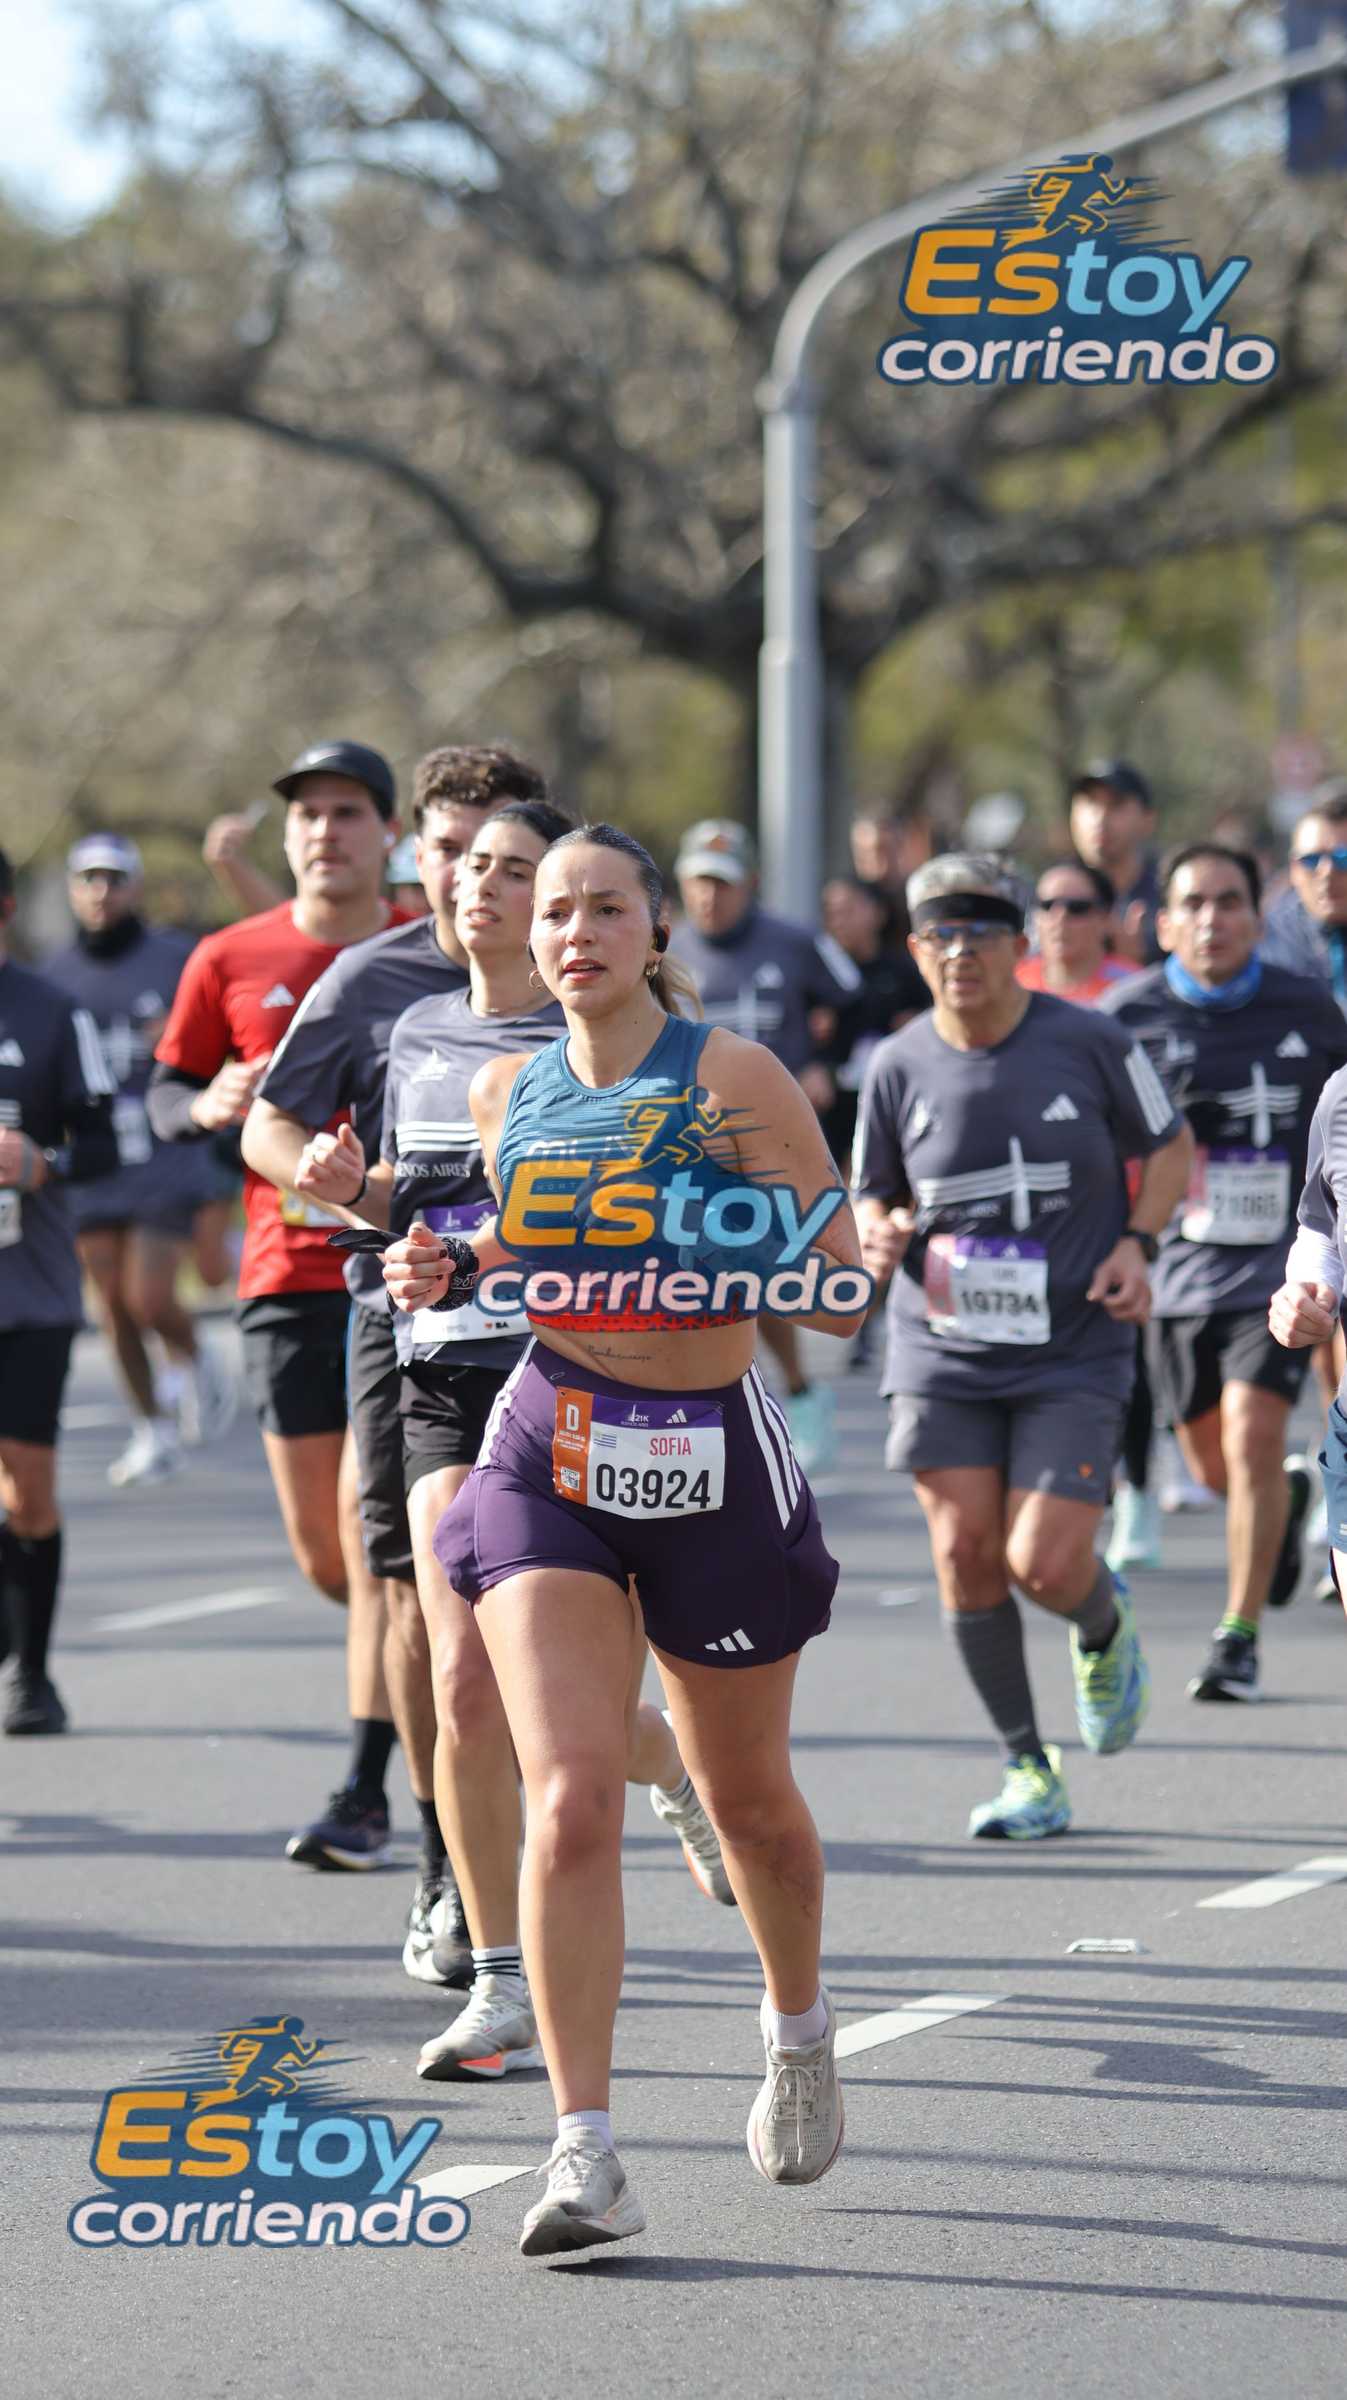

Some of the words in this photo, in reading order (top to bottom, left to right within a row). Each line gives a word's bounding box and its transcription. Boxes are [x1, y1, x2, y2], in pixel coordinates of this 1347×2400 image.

[396, 1161, 429, 1178] ENOS
[431, 1163, 471, 1178] AIRES
[960, 1286, 1040, 1317] 19734
[566, 1403, 579, 1431] D
[634, 1414, 650, 1423] 21K
[649, 1436, 692, 1457] SOFIA
[596, 1463, 711, 1509] 03924
